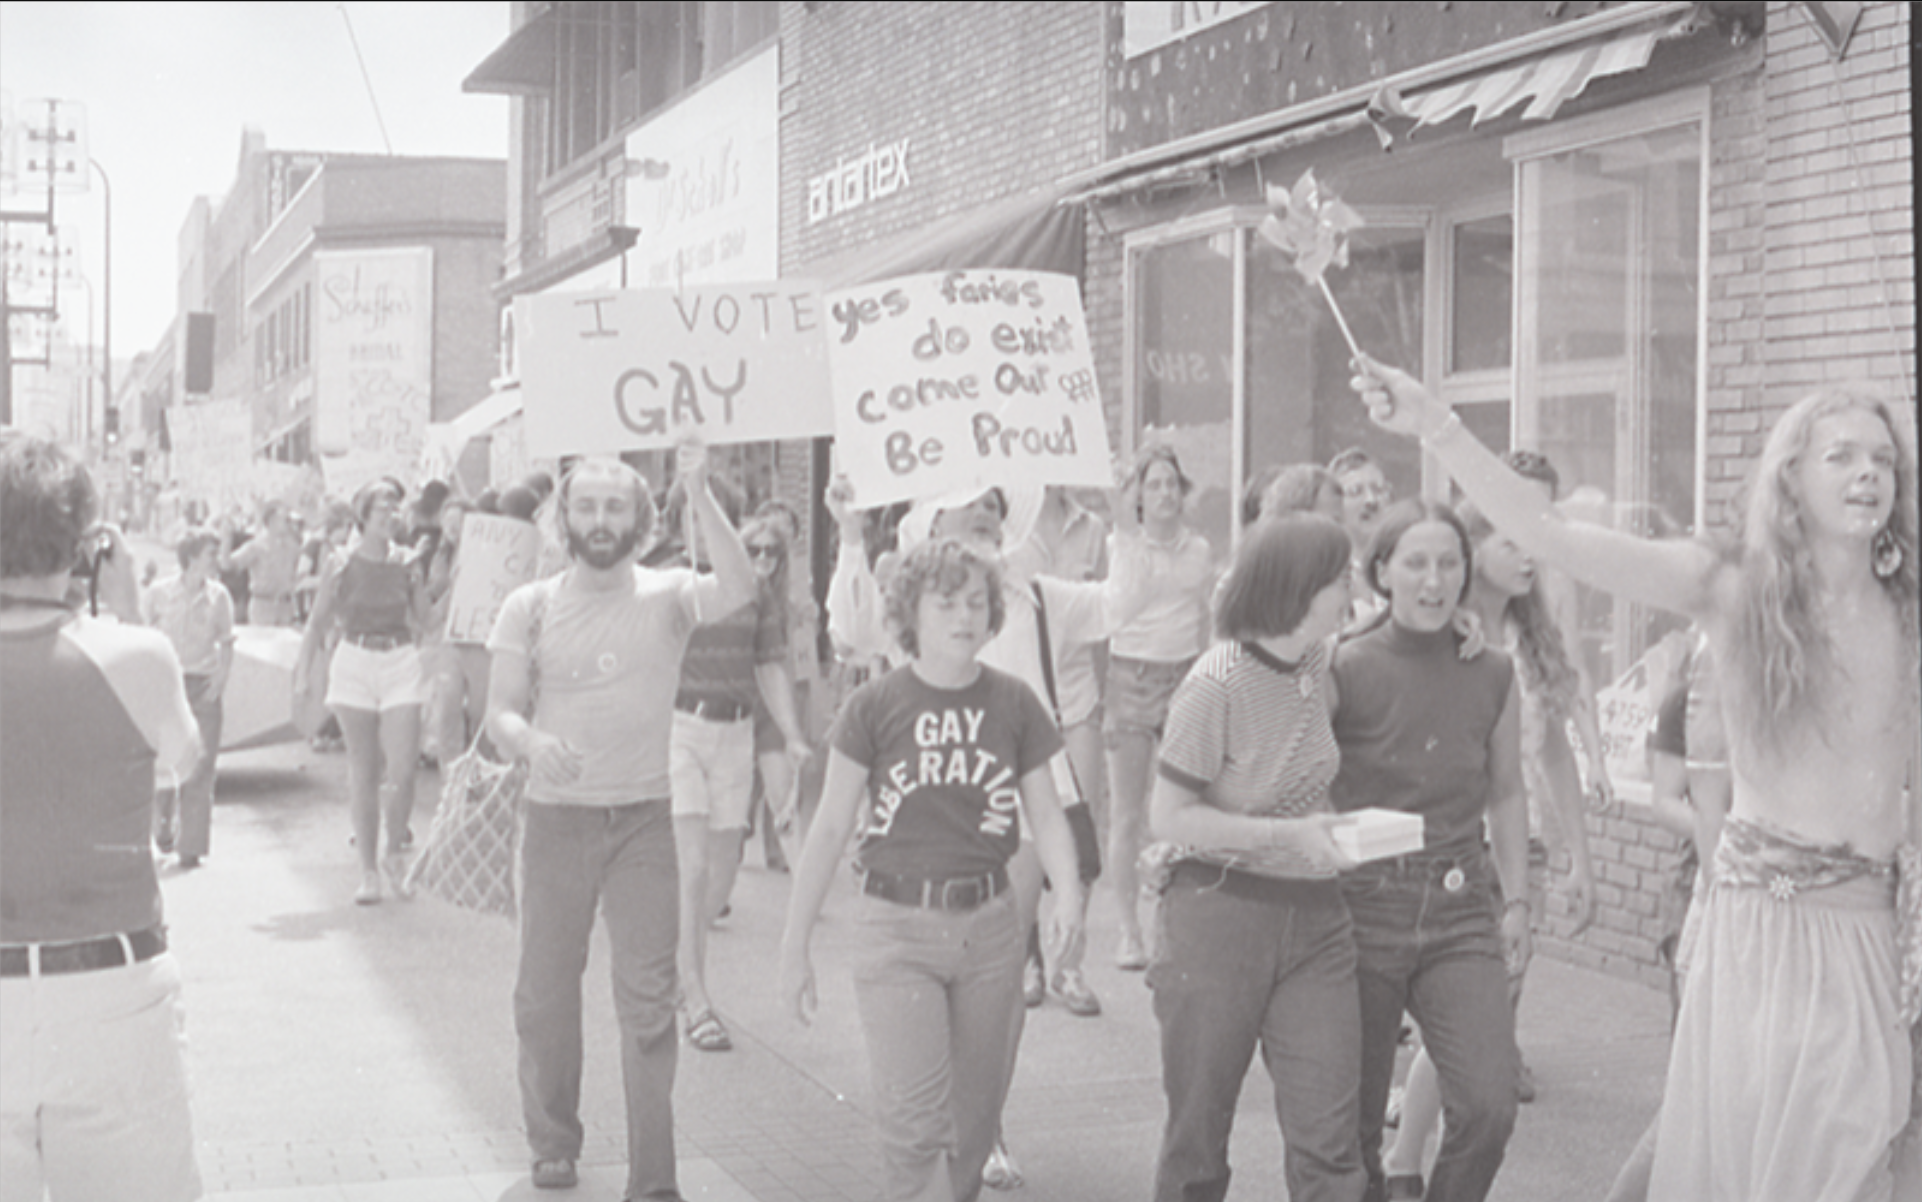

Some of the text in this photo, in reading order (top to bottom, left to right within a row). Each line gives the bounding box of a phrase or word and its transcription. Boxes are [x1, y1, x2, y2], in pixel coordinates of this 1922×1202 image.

[574, 292, 817, 338] I VOTE
[832, 288, 910, 344] yes
[911, 316, 970, 362] do
[612, 356, 747, 435] GAY
[856, 373, 980, 424] come
[884, 411, 1077, 476] Be Proud
[470, 519, 522, 547] ANY
[914, 708, 985, 748] GAY
[866, 749, 1022, 836] LIBERATION
